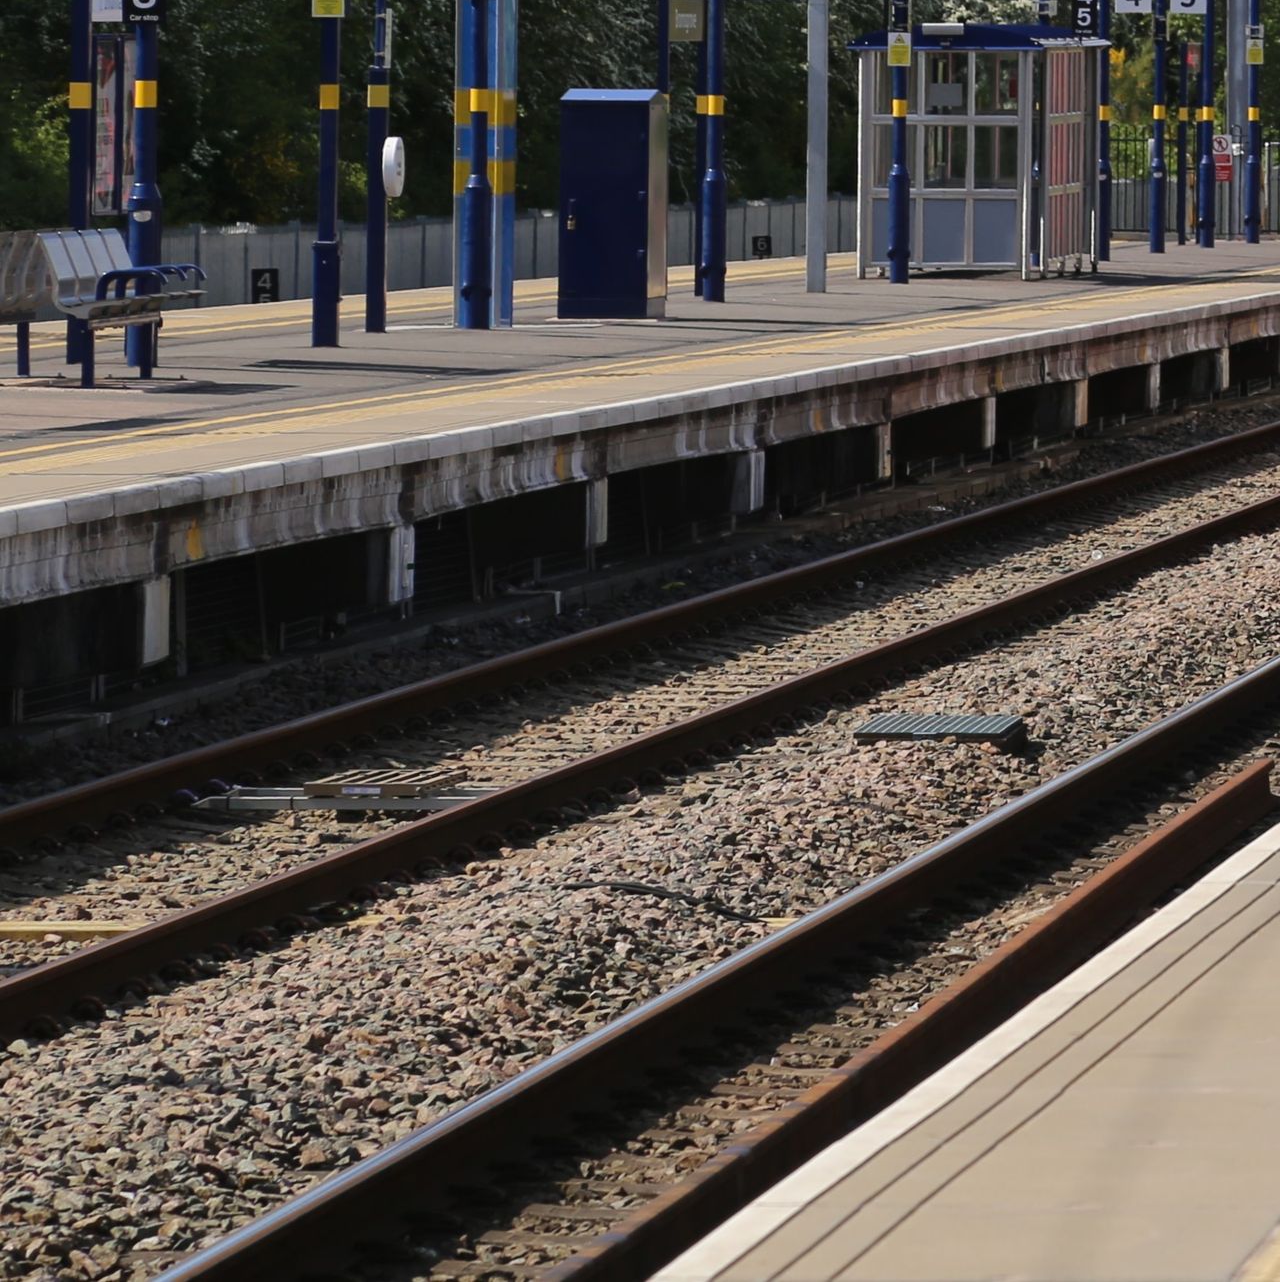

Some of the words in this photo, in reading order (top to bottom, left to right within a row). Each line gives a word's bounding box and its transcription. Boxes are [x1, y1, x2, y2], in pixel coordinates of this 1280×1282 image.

[143, 14, 159, 22] stop
[1077, 8, 1091, 26] 5
[757, 238, 768, 251] 6
[257, 272, 272, 290] 4
